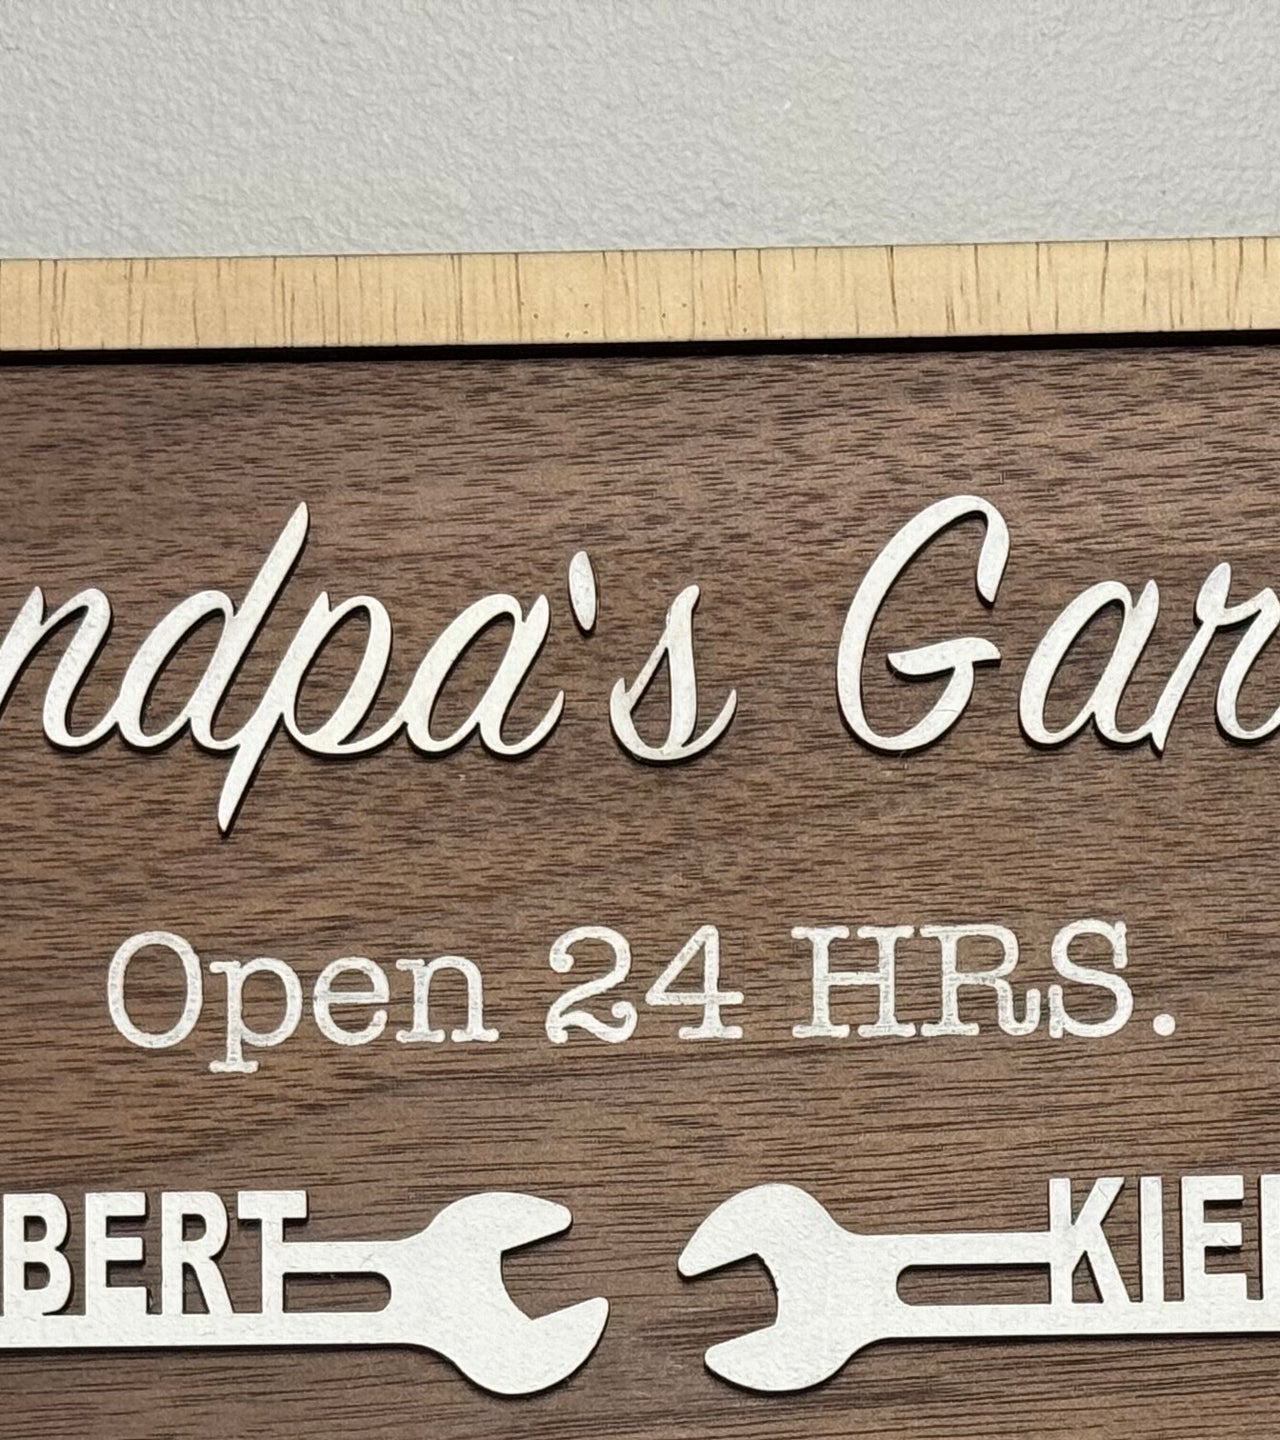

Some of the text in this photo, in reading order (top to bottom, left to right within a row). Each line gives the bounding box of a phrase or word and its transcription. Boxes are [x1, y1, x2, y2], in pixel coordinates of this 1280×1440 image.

[106, 918, 1177, 1075] Open 24 HRS.
